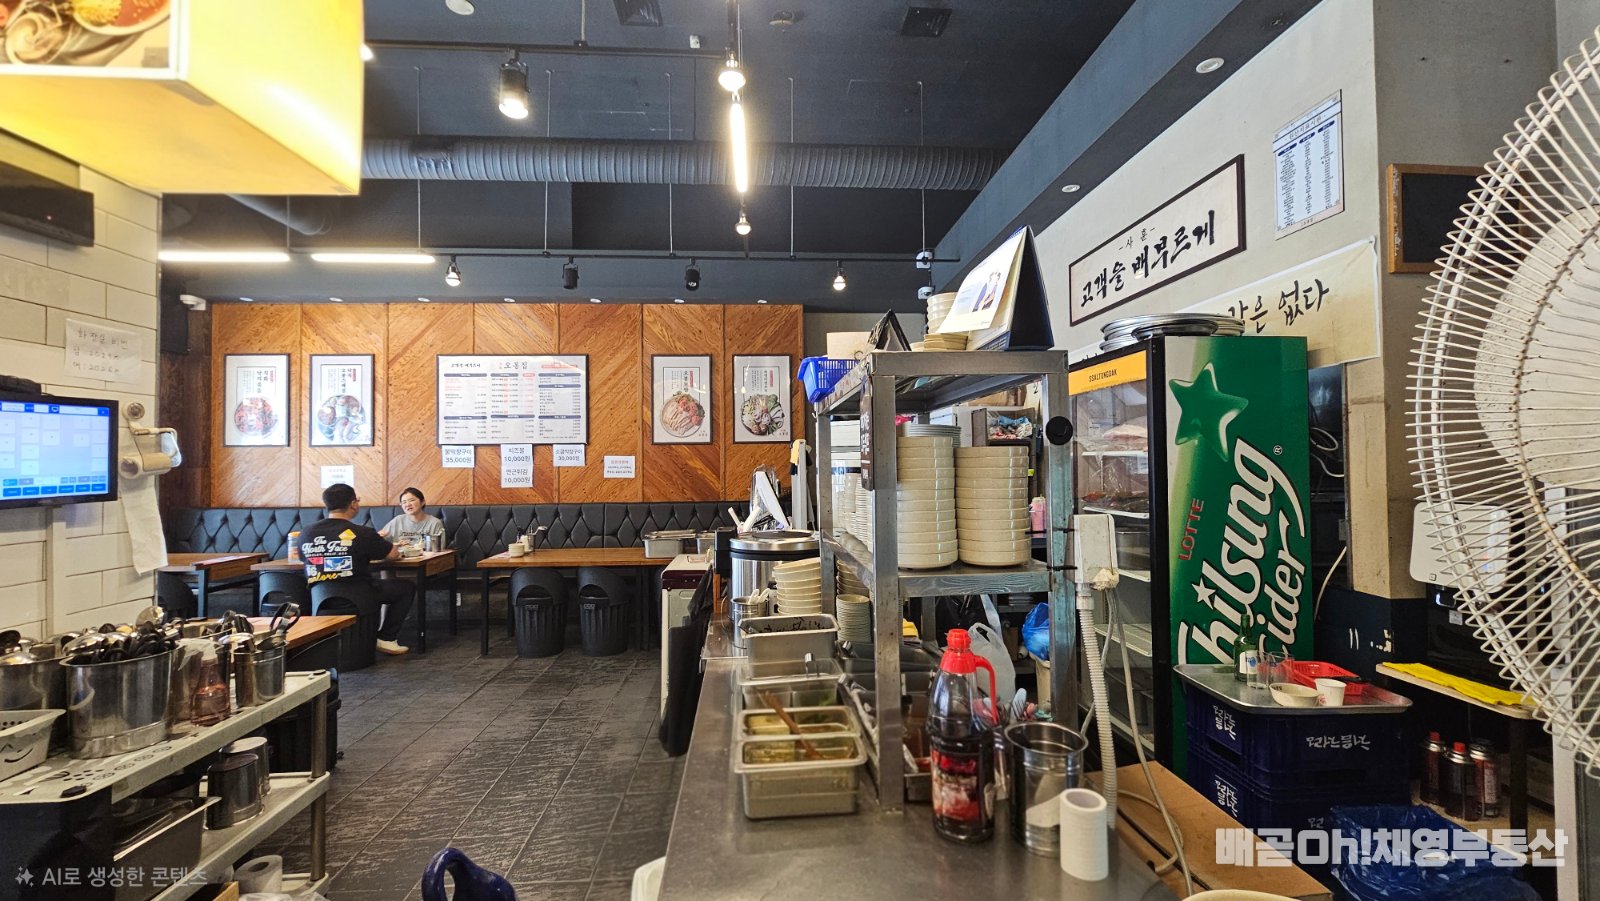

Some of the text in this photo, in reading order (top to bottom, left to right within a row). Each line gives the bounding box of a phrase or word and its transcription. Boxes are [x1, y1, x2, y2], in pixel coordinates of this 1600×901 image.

[1080, 209, 1215, 307] 고객을 배부르게
[1278, 278, 1330, 327] 없다
[302, 540, 349, 554] North Face
[1177, 498, 1205, 561] LOTTE
